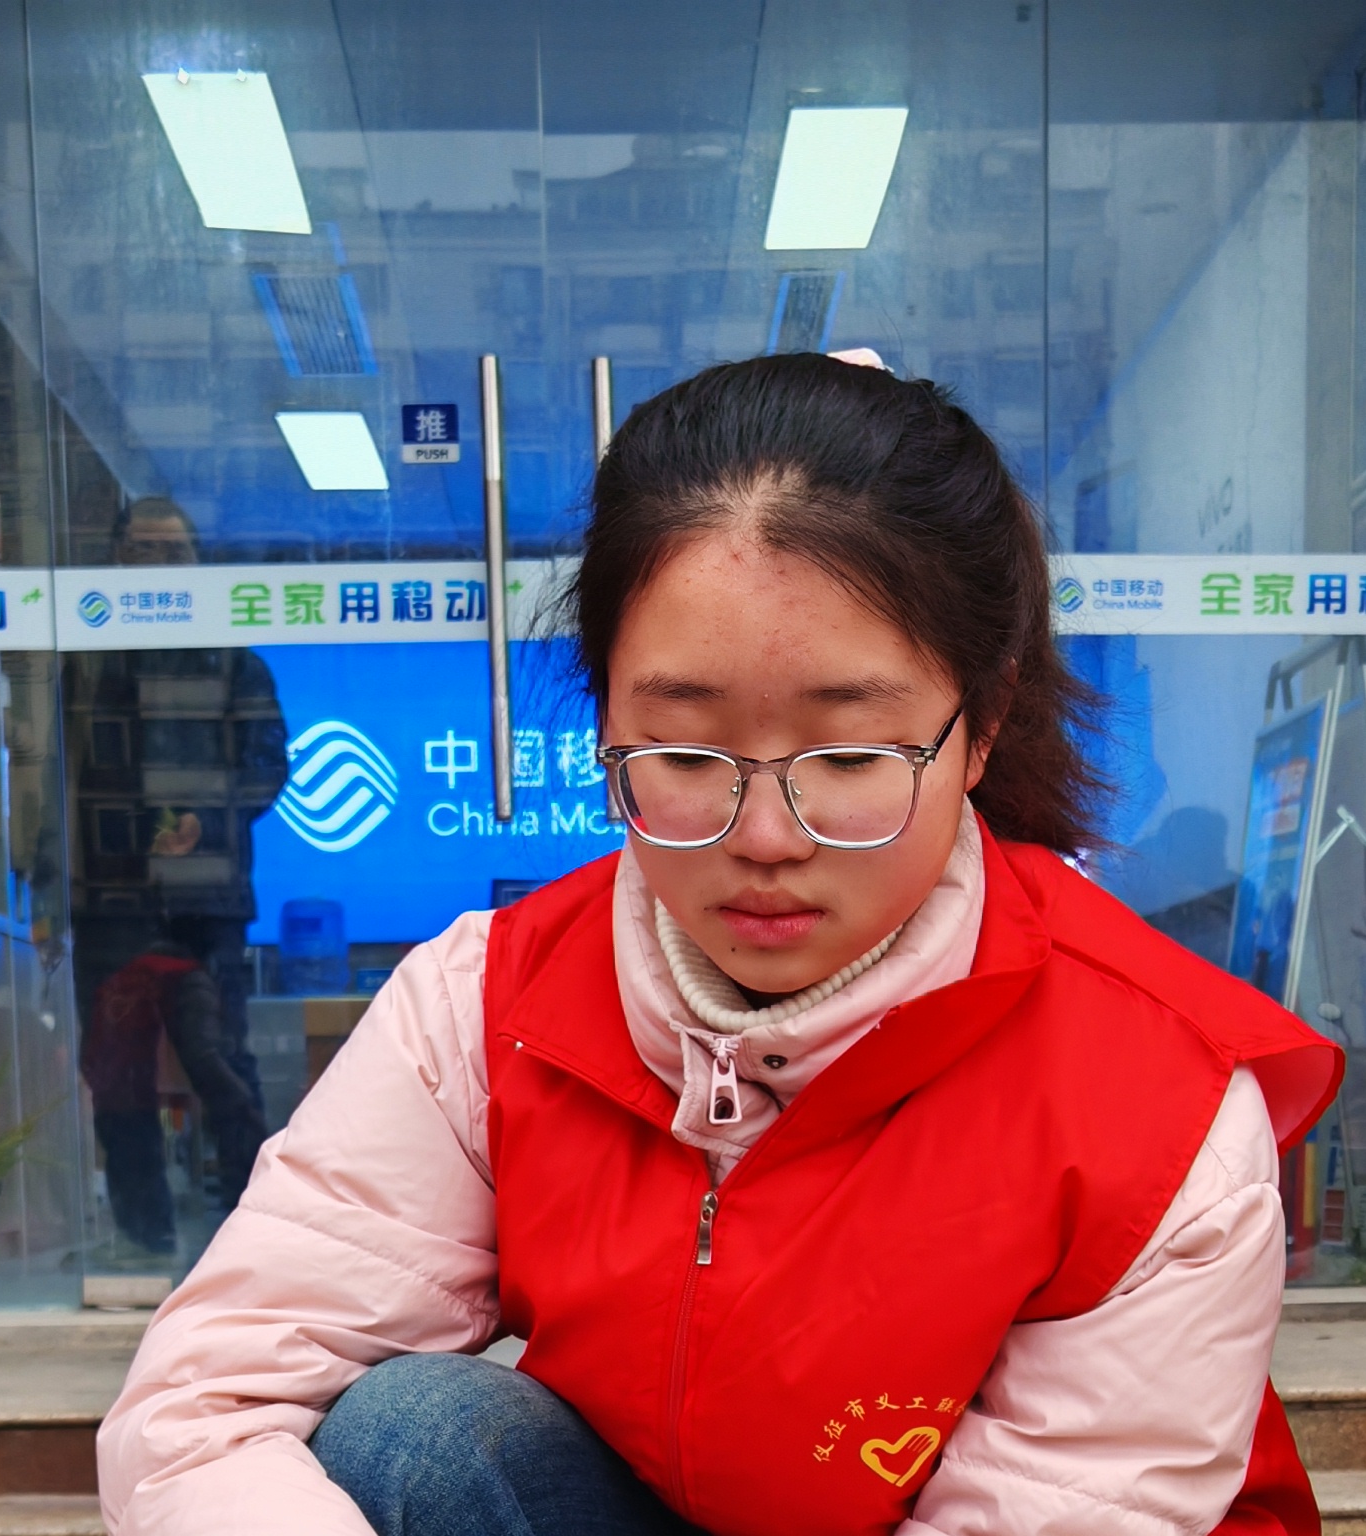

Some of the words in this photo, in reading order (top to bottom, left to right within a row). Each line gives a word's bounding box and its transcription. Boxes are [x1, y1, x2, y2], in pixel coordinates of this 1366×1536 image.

[415, 409, 449, 442] 推
[415, 449, 449, 461] PUSH
[1092, 579, 1164, 597] 中国移动
[120, 592, 193, 611] 中国移动
[230, 580, 487, 627] 全家用移动
[1092, 599, 1125, 610] China
[1127, 599, 1164, 610] Mobile
[121, 613, 154, 624] China
[156, 612, 193, 624] Mobile
[551, 801, 627, 836] Mo
